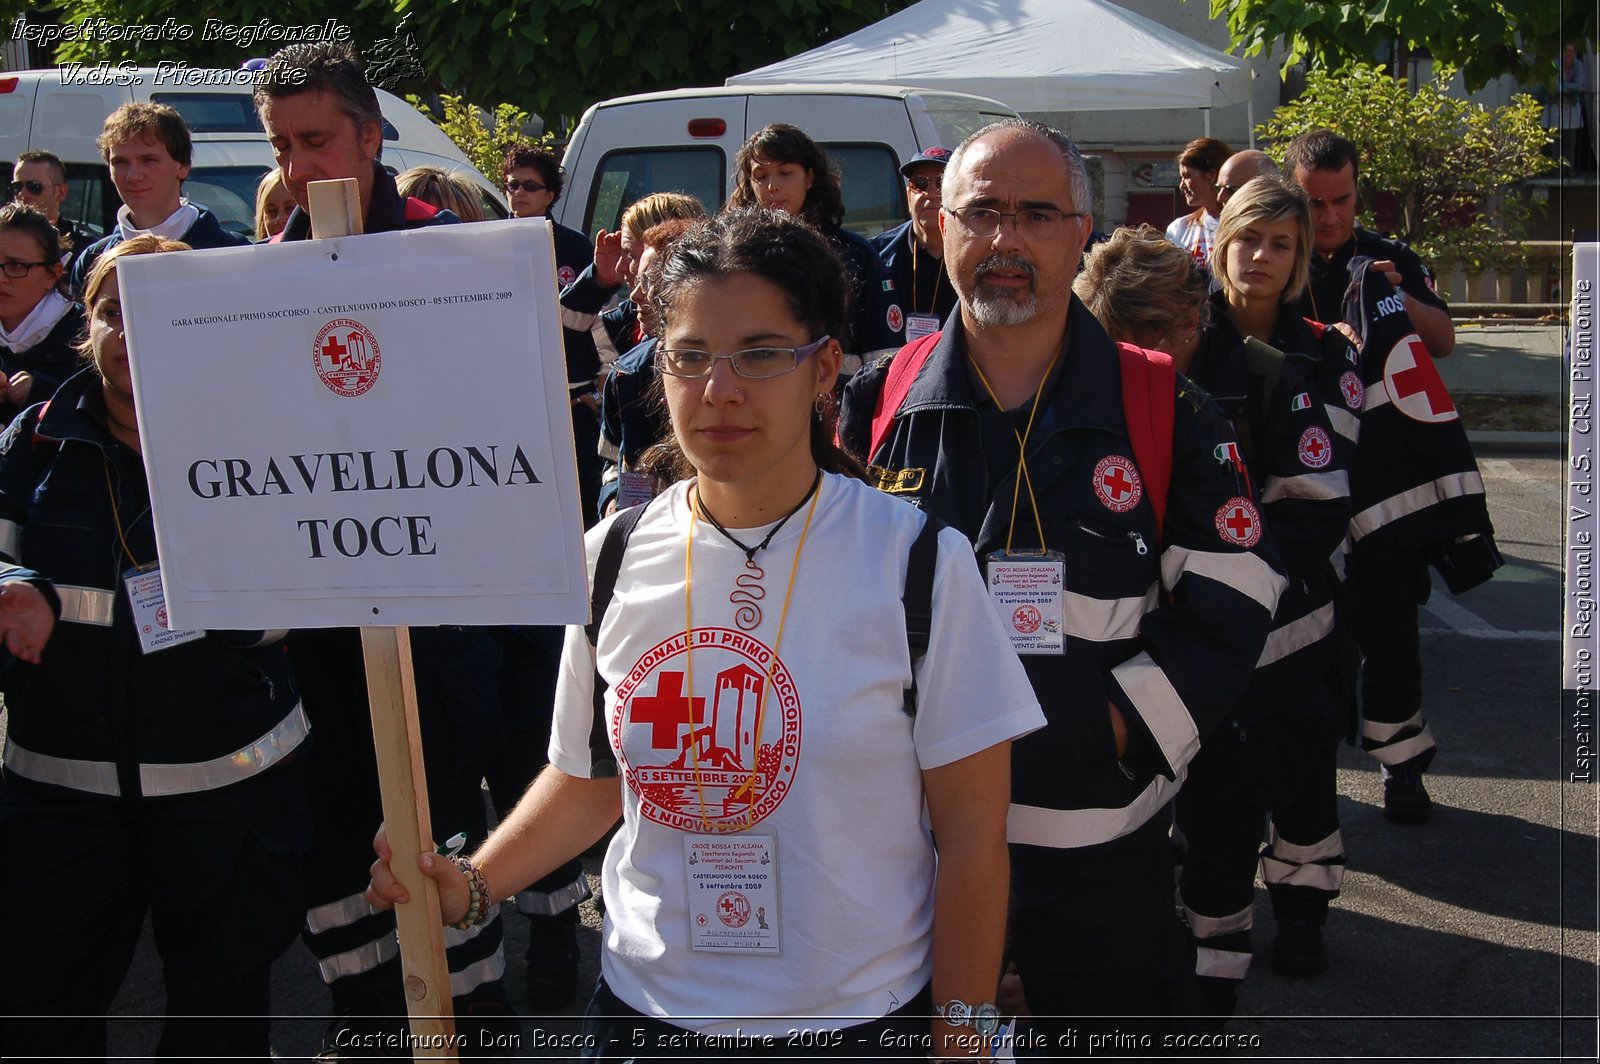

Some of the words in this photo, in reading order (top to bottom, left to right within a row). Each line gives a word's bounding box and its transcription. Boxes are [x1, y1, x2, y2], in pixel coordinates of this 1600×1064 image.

[171, 319, 193, 327] GARA
[194, 314, 239, 325] REGIONALE
[240, 312, 266, 321] PRIMO
[267, 308, 310, 318] SOCCORSO
[317, 302, 378, 315] CASTELNUOVO
[379, 301, 397, 309] DON
[398, 298, 426, 308] BOSCO
[433, 296, 442, 305] 05
[443, 292, 495, 304] SETTEMBRE
[496, 291, 513, 300] 2009
[1376, 294, 1406, 316] ROS
[345, 320, 363, 331] PRIMO
[187, 444, 543, 499] GRAVELLONA
[297, 515, 437, 558] TOCE
[150, 636, 173, 646] CANINO
[700, 631, 716, 643] DI
[722, 633, 770, 664] PRIMO
[617, 631, 694, 700] REGIONALE
[769, 662, 798, 758] SOCCORSO
[612, 704, 623, 750] GARA
[641, 771, 649, 781] 5
[652, 770, 728, 784] SETTEMBRE
[751, 780, 787, 821] BOSCO
[706, 882, 742, 890] settembre
